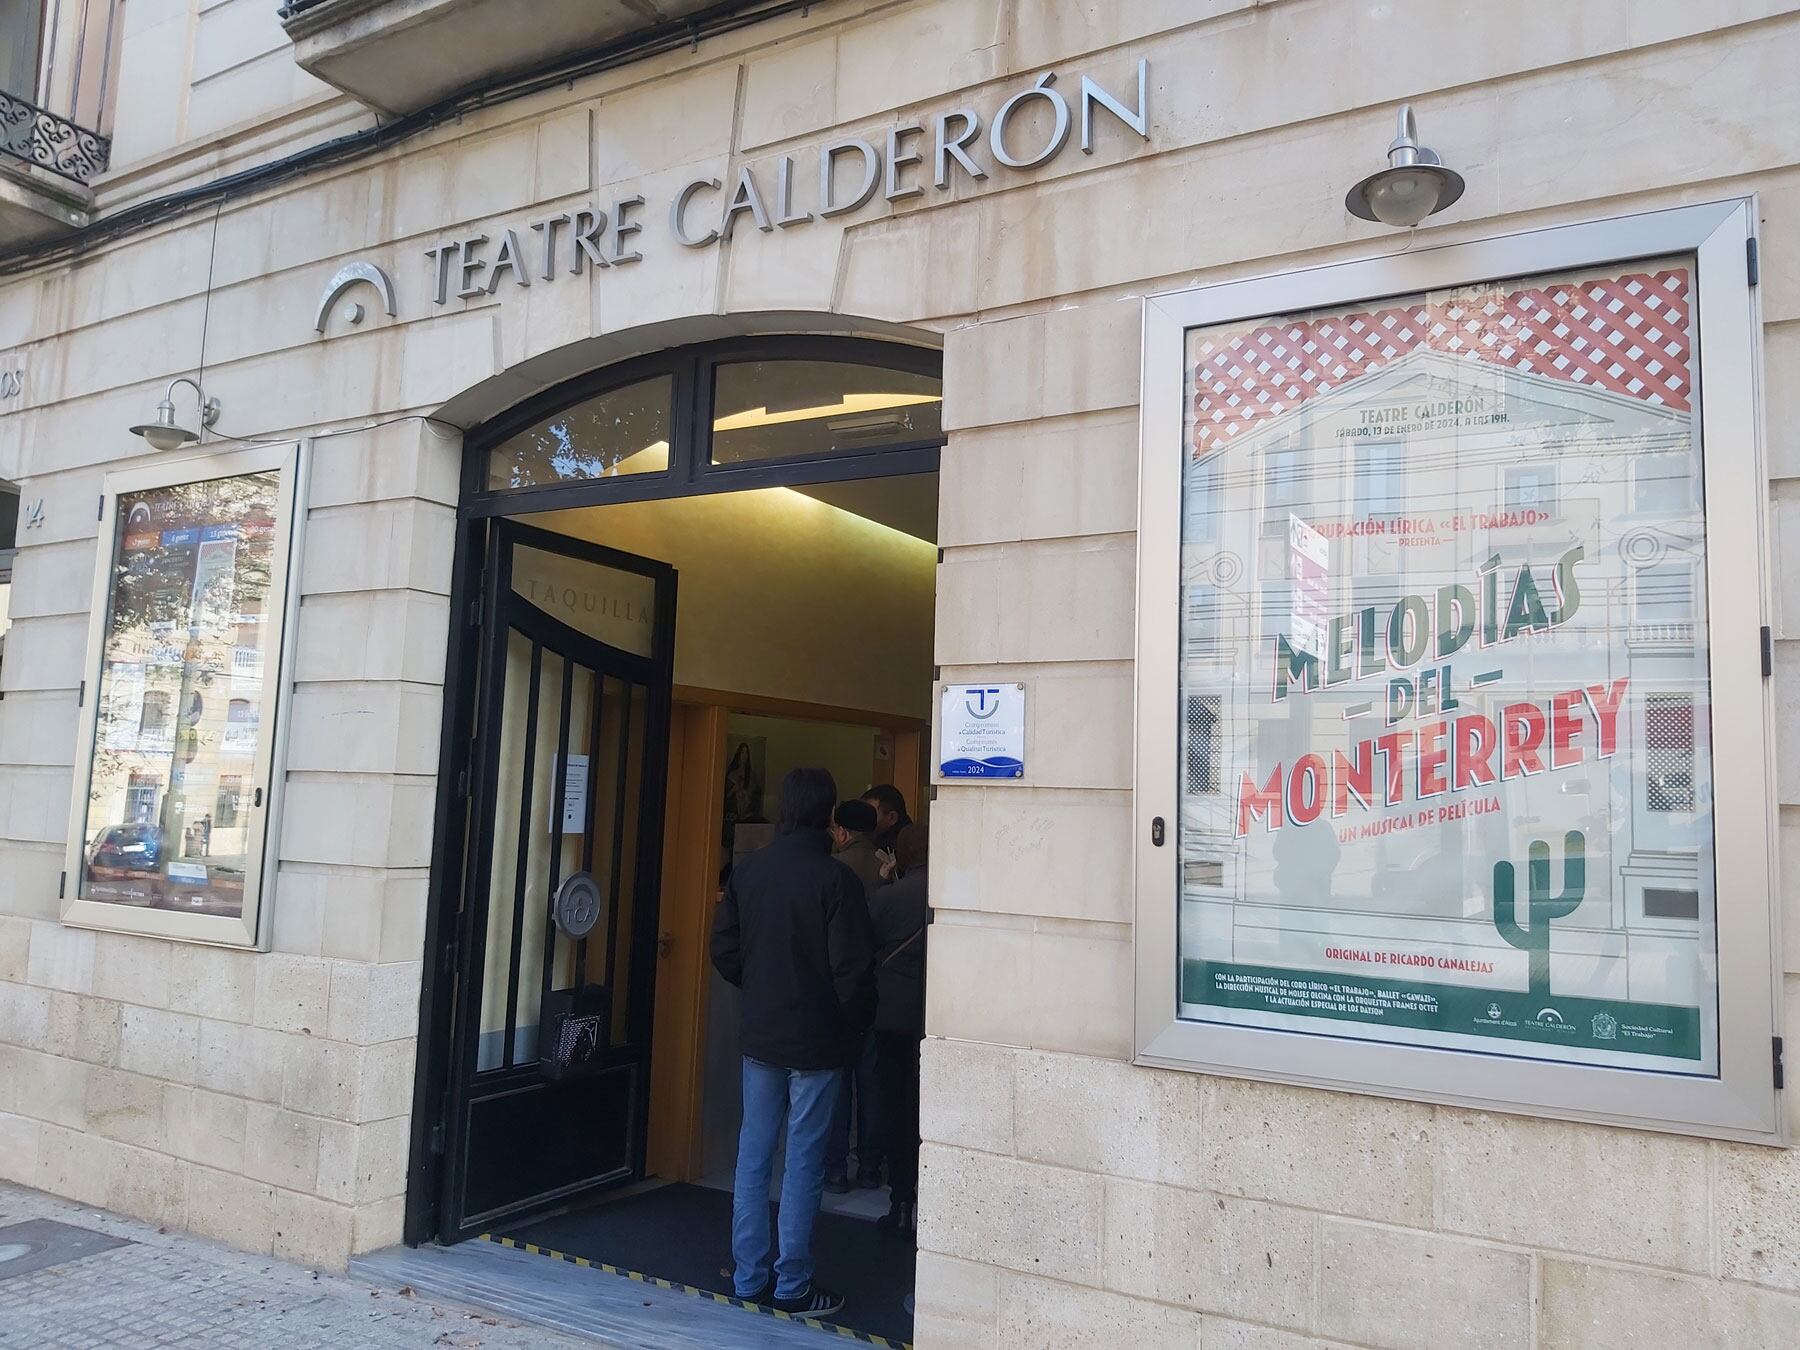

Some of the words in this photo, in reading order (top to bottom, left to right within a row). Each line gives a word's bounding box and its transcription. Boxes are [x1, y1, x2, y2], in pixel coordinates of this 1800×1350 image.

[425, 195, 645, 306] TEATRE
[668, 58, 1151, 249] CALDERÓN
[1360, 406, 1408, 425] TEATRE
[1415, 395, 1484, 420] CALDERÓN
[1335, 425, 1371, 438] SÁBADO,
[1373, 426, 1382, 436] 13
[1384, 425, 1394, 435] DE
[1396, 423, 1422, 434] ENERO
[1425, 421, 1435, 431] DE
[1437, 418, 1462, 429] 2024,
[1465, 417, 1471, 426] A
[1473, 415, 1489, 425] LAS
[1491, 413, 1510, 424] 19H.
[26, 499, 45, 530] 14
[1390, 516, 1435, 535] LÍRICA
[1398, 537, 1441, 547] PRESENTA
[528, 579, 649, 625] TAQUILLA
[1272, 545, 1584, 704] MELODÍAS
[1386, 664, 1460, 728] DEL
[967, 766, 985, 774] 2024
[1234, 677, 1630, 840] MONTERREY
[1339, 826, 1357, 843] UN
[1360, 816, 1414, 839] MUSICAL
[1419, 809, 1434, 827] DE
[1438, 796, 1501, 823] PELÍCULA
[565, 906, 593, 924] TCA
[1326, 947, 1371, 963] ORIGINAL
[1374, 952, 1387, 964] DE
[1390, 954, 1435, 968] RICARDO
[1438, 957, 1494, 973] CANALEJAS
[1214, 973, 1227, 981] CON
[1227, 974, 1235, 982] LA
[1235, 975, 1279, 986] PARTICIPACIÓN
[1291, 981, 1307, 989] CORO
[1377, 990, 1400, 999] BALLET
[1223, 982, 1253, 992] DIRECCIÓN
[1254, 985, 1279, 995] MUSICAL
[1280, 988, 1287, 996] DE
[1332, 993, 1346, 1002] CON
[1346, 995, 1354, 1003] LA
[1354, 996, 1392, 1008] ORQUESTRA
[1418, 1003, 1439, 1013] OCTET
[1264, 995, 1269, 1003] Y
[1277, 997, 1310, 1007] ACTUACIÓN
[1311, 1000, 1337, 1010] ESPECIAL
[1338, 1004, 1347, 1012] DE
[1347, 1004, 1358, 1013] LOS
[1621, 1023, 1648, 1032] Sociedad
[1649, 1026, 1673, 1034] Cultural
